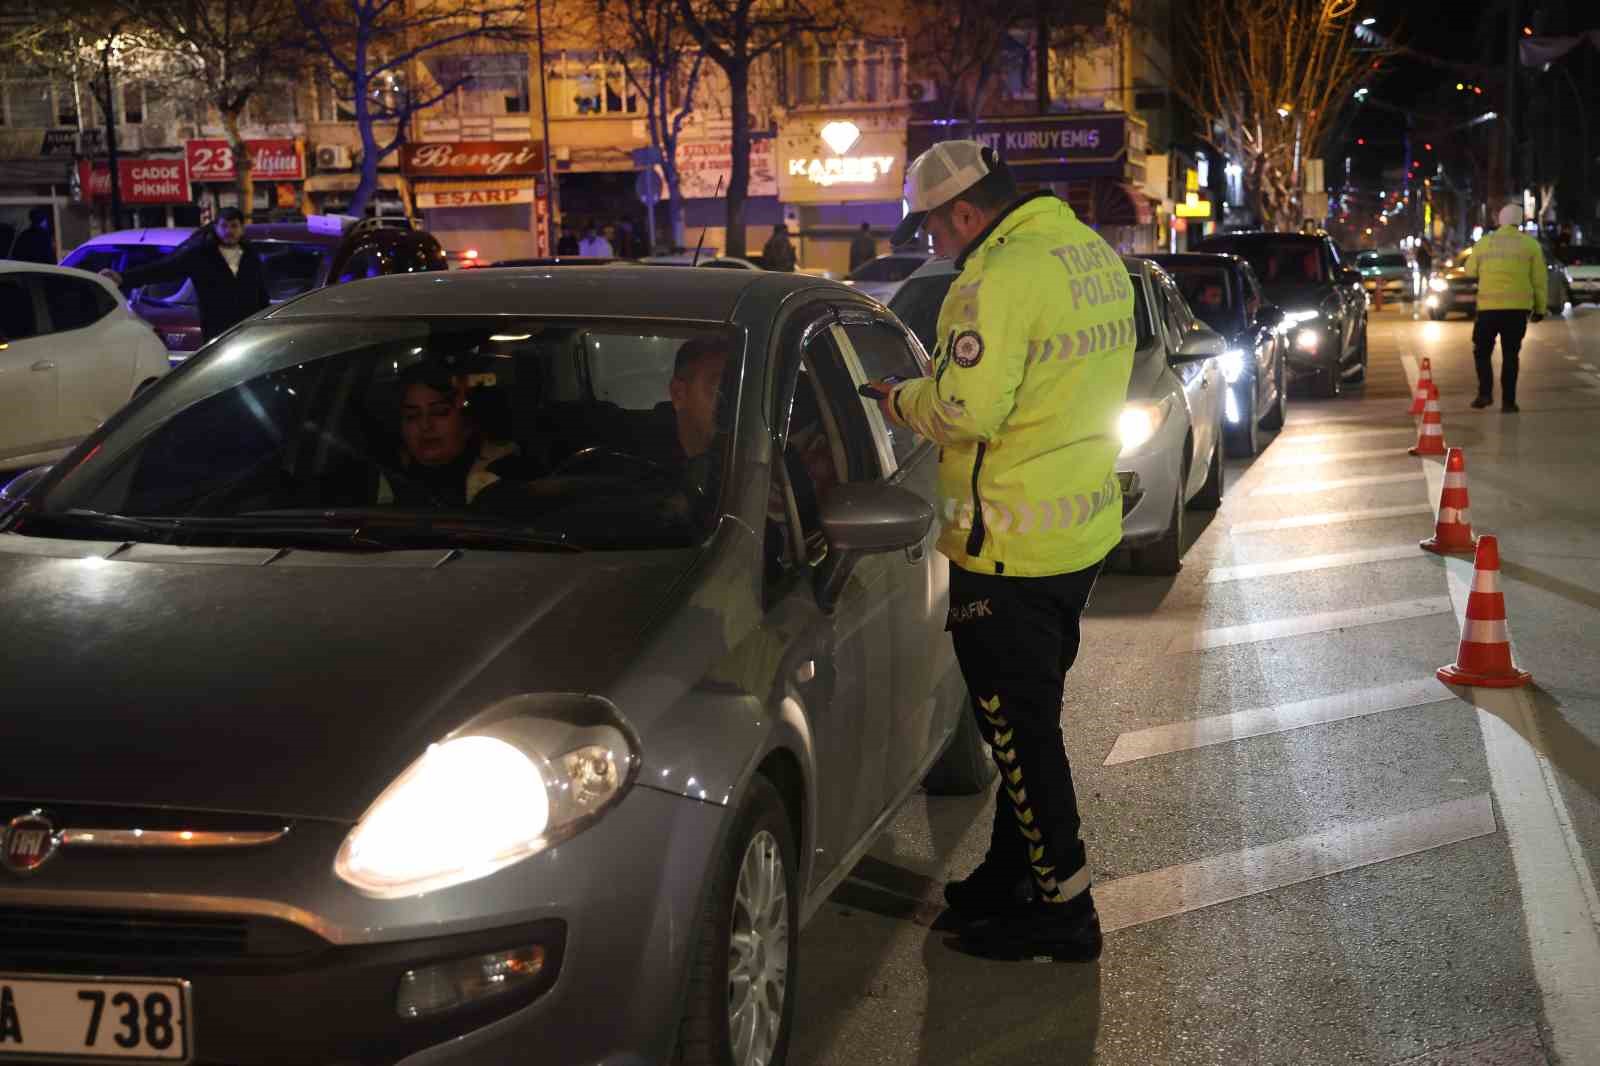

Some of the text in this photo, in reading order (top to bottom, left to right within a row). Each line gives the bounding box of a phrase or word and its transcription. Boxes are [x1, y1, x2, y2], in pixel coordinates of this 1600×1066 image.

[131, 166, 179, 180] CADDE
[191, 147, 233, 172] 23
[411, 143, 536, 175] Bengi
[77, 988, 173, 1050] 738
